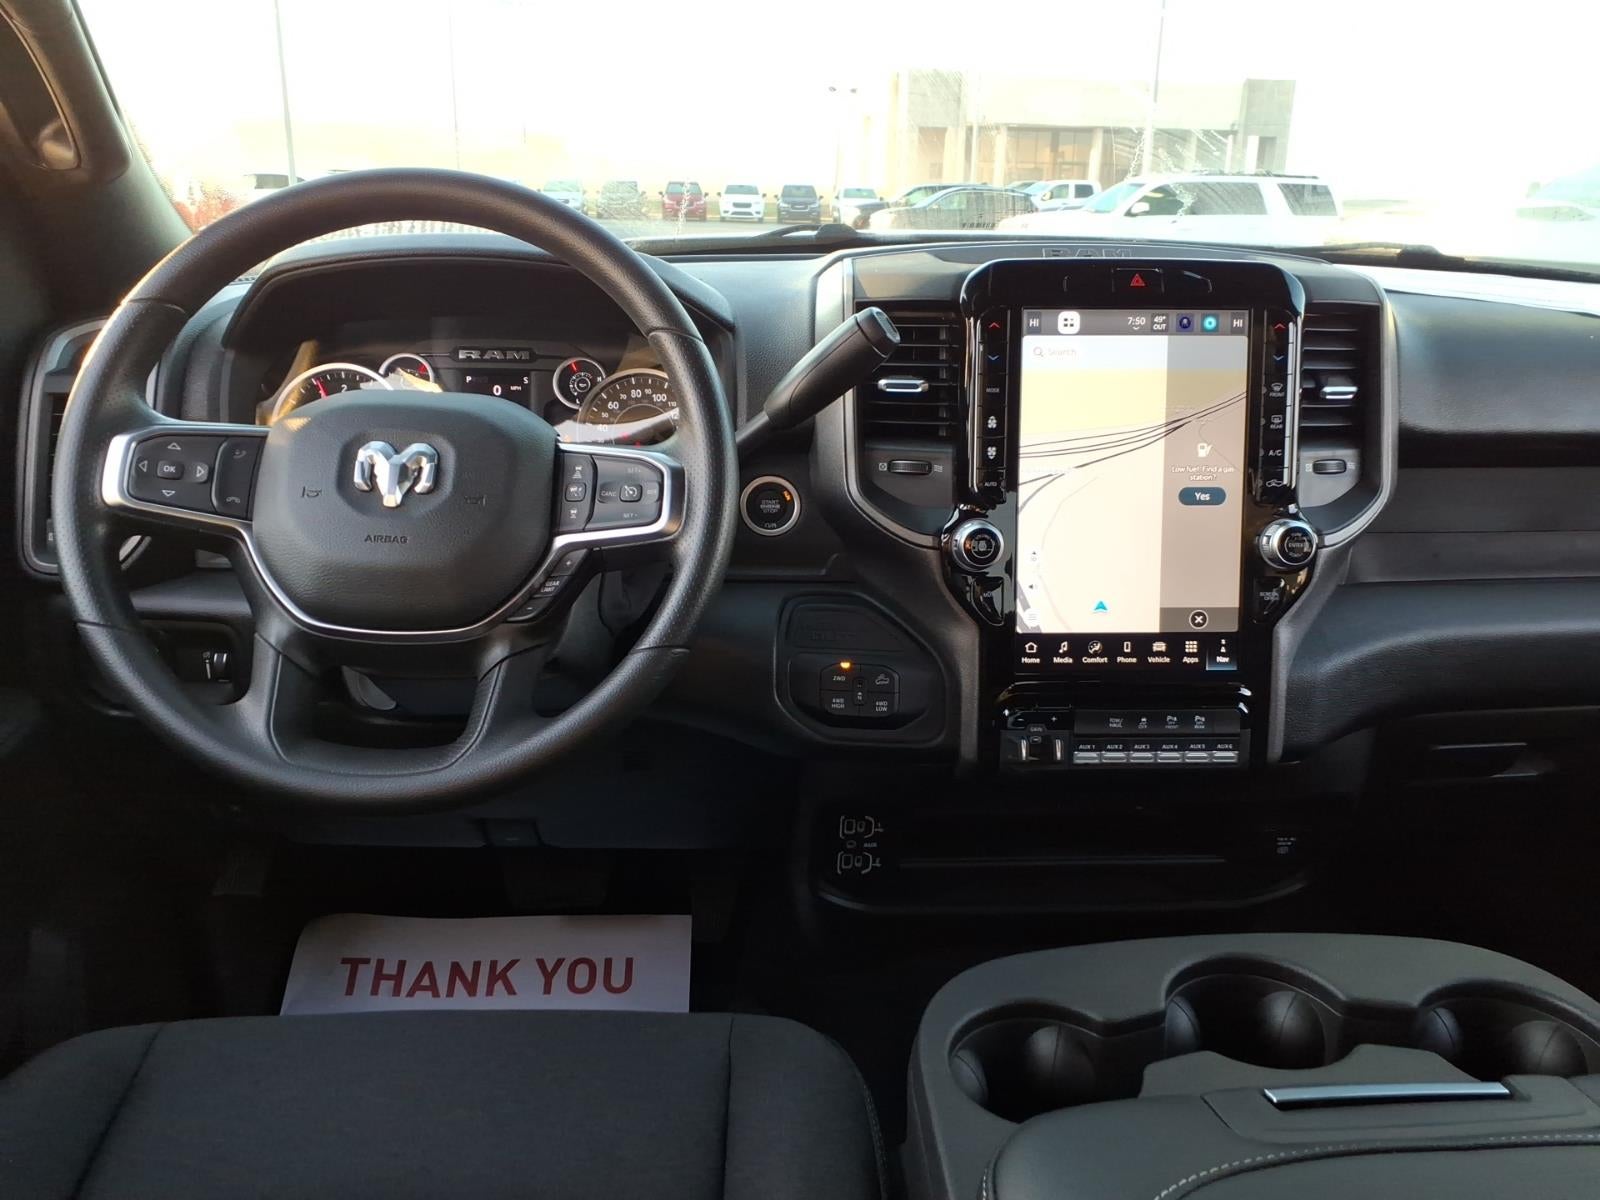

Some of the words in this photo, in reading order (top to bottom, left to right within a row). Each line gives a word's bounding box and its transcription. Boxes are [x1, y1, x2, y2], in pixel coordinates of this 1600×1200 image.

[1029, 319, 1039, 327] HI
[1127, 316, 1146, 325] 7:50
[1233, 319, 1243, 327] HI
[458, 350, 530, 360] RAM
[492, 384, 502, 396] 0
[630, 390, 642, 398] 80
[652, 393, 667, 402] 100
[608, 401, 618, 410] 60
[1195, 492, 1210, 500] Yes
[364, 534, 408, 544] AIRBAG
[1182, 656, 1198, 665] Apps
[340, 957, 521, 998] THANK
[535, 956, 634, 996] YOU
